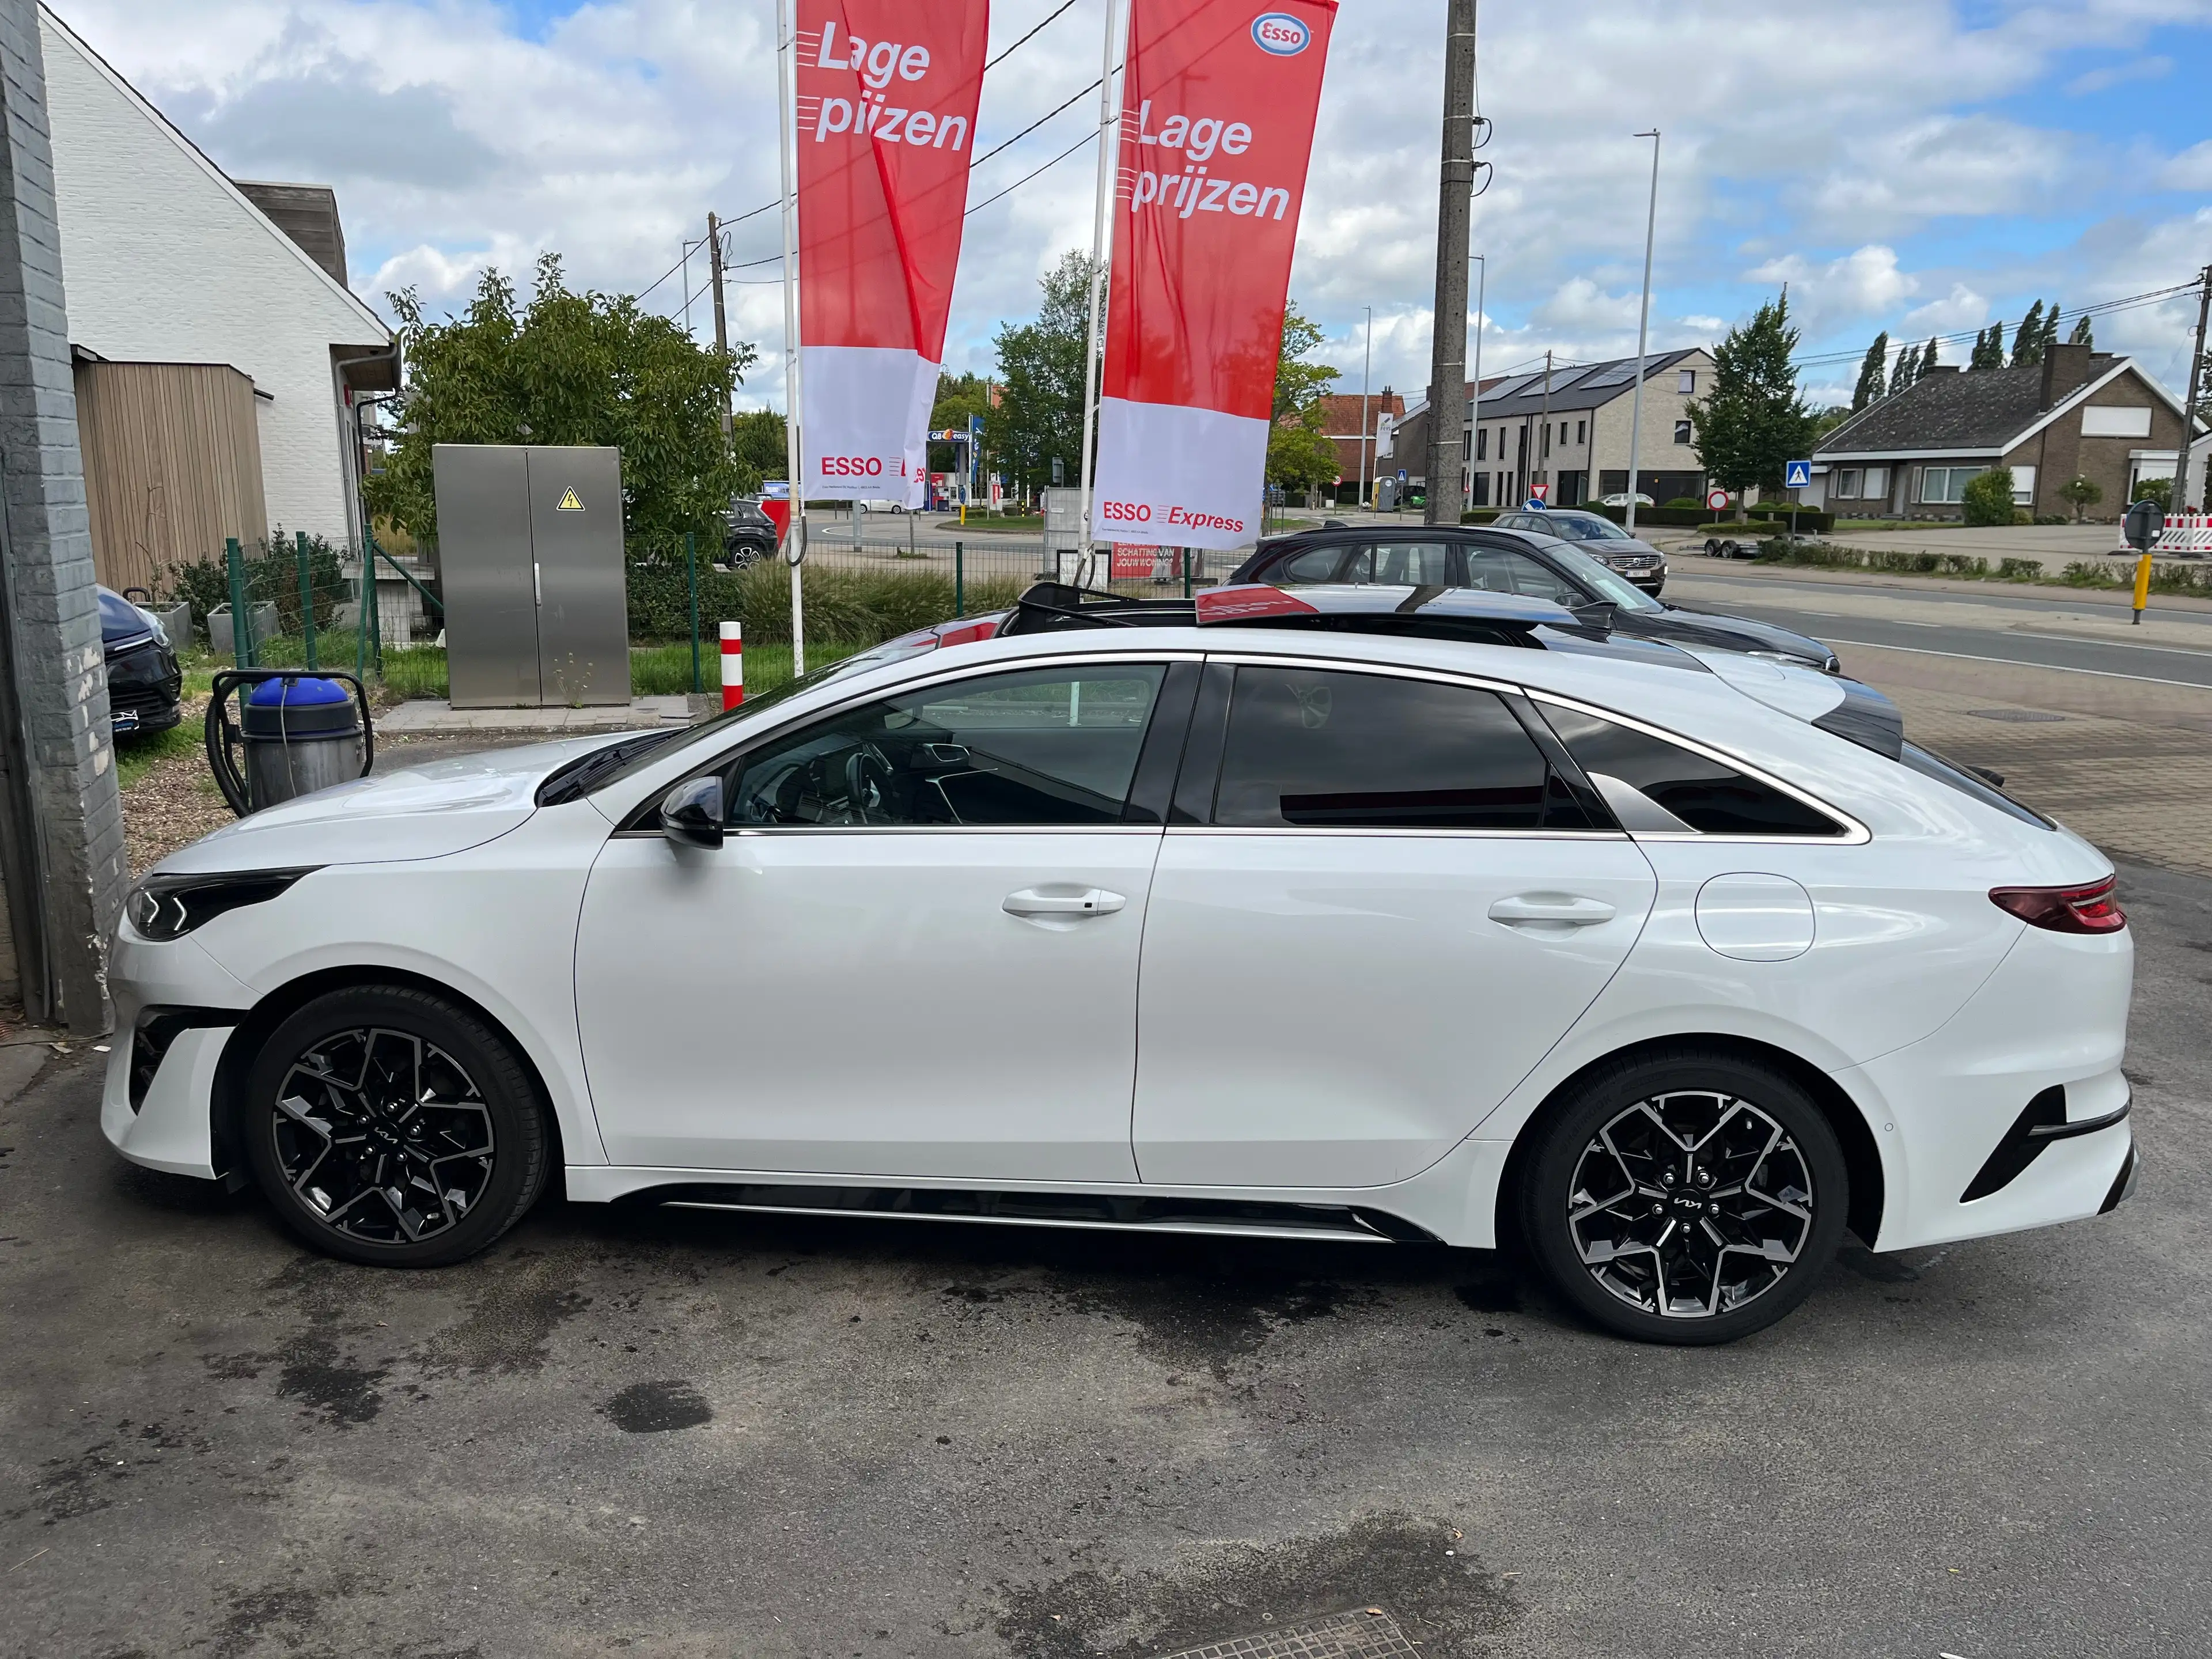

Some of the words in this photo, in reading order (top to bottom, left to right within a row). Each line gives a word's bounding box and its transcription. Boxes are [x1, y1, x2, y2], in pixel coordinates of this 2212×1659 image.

[818, 21, 930, 89] Lage
[1138, 100, 1252, 162] Lage
[1131, 165, 1290, 221] prijzen
[953, 433, 969, 441] easy
[821, 457, 882, 476] ESSO
[1103, 501, 1152, 522] ESSO
[1168, 506, 1244, 533] Express
[1116, 558, 1139, 567] JOUW
[1117, 548, 1157, 557] SCHATTING
[1158, 548, 1175, 557] VAN
